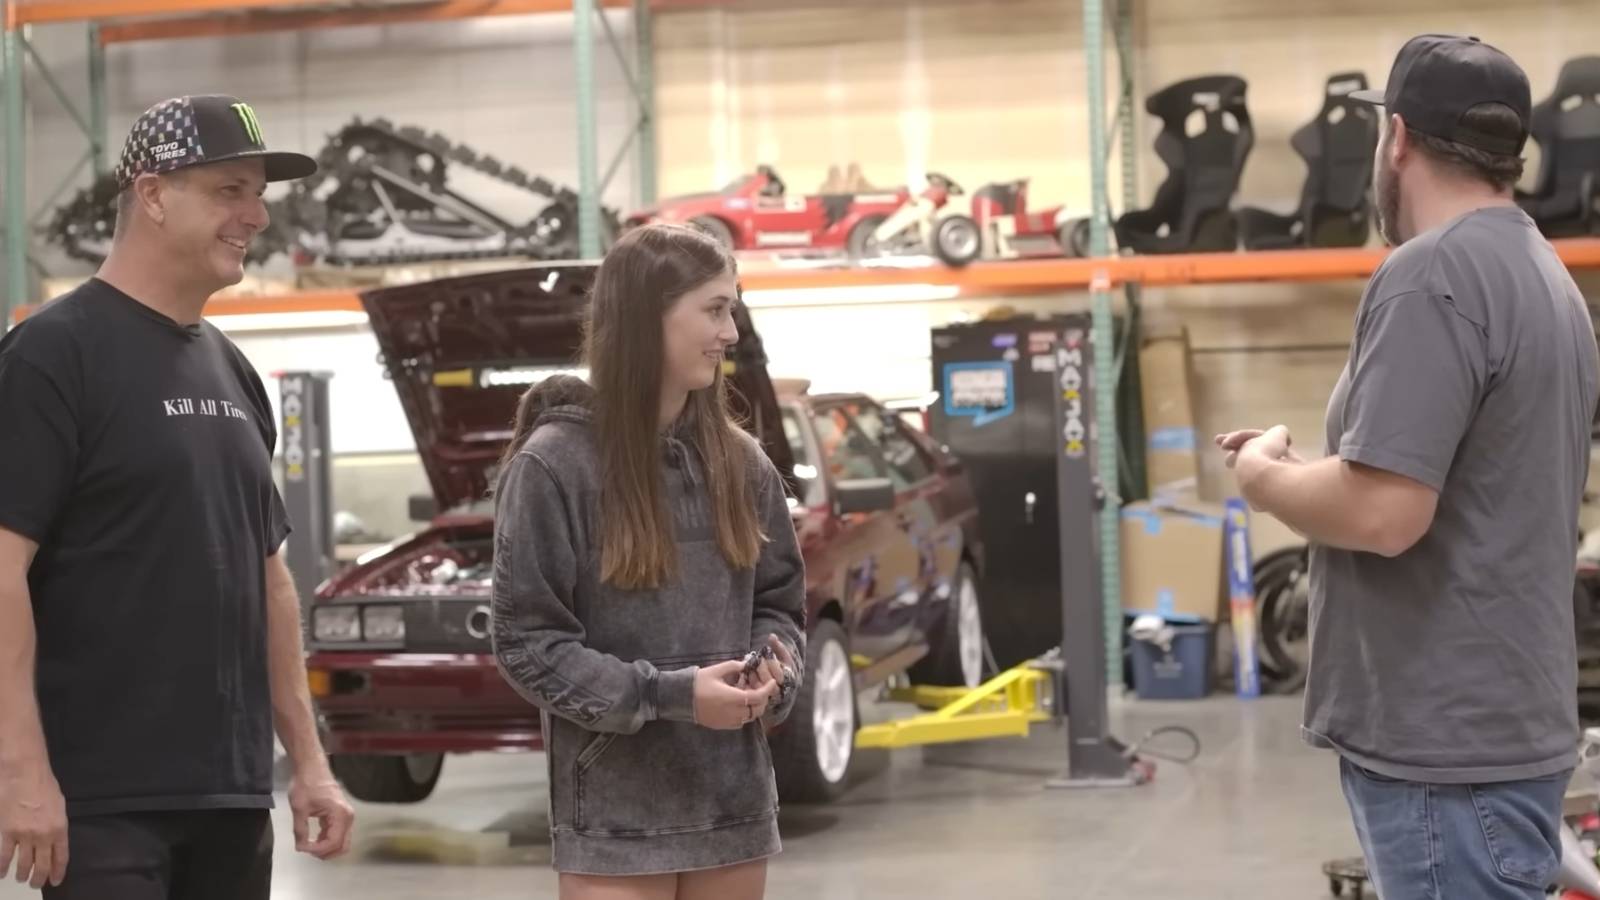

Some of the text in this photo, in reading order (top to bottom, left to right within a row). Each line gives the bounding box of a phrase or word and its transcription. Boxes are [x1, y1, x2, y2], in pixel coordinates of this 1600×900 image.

[150, 141, 179, 156] TOYO
[154, 147, 188, 162] TIRES
[162, 397, 195, 417] Kill
[199, 398, 218, 417] All
